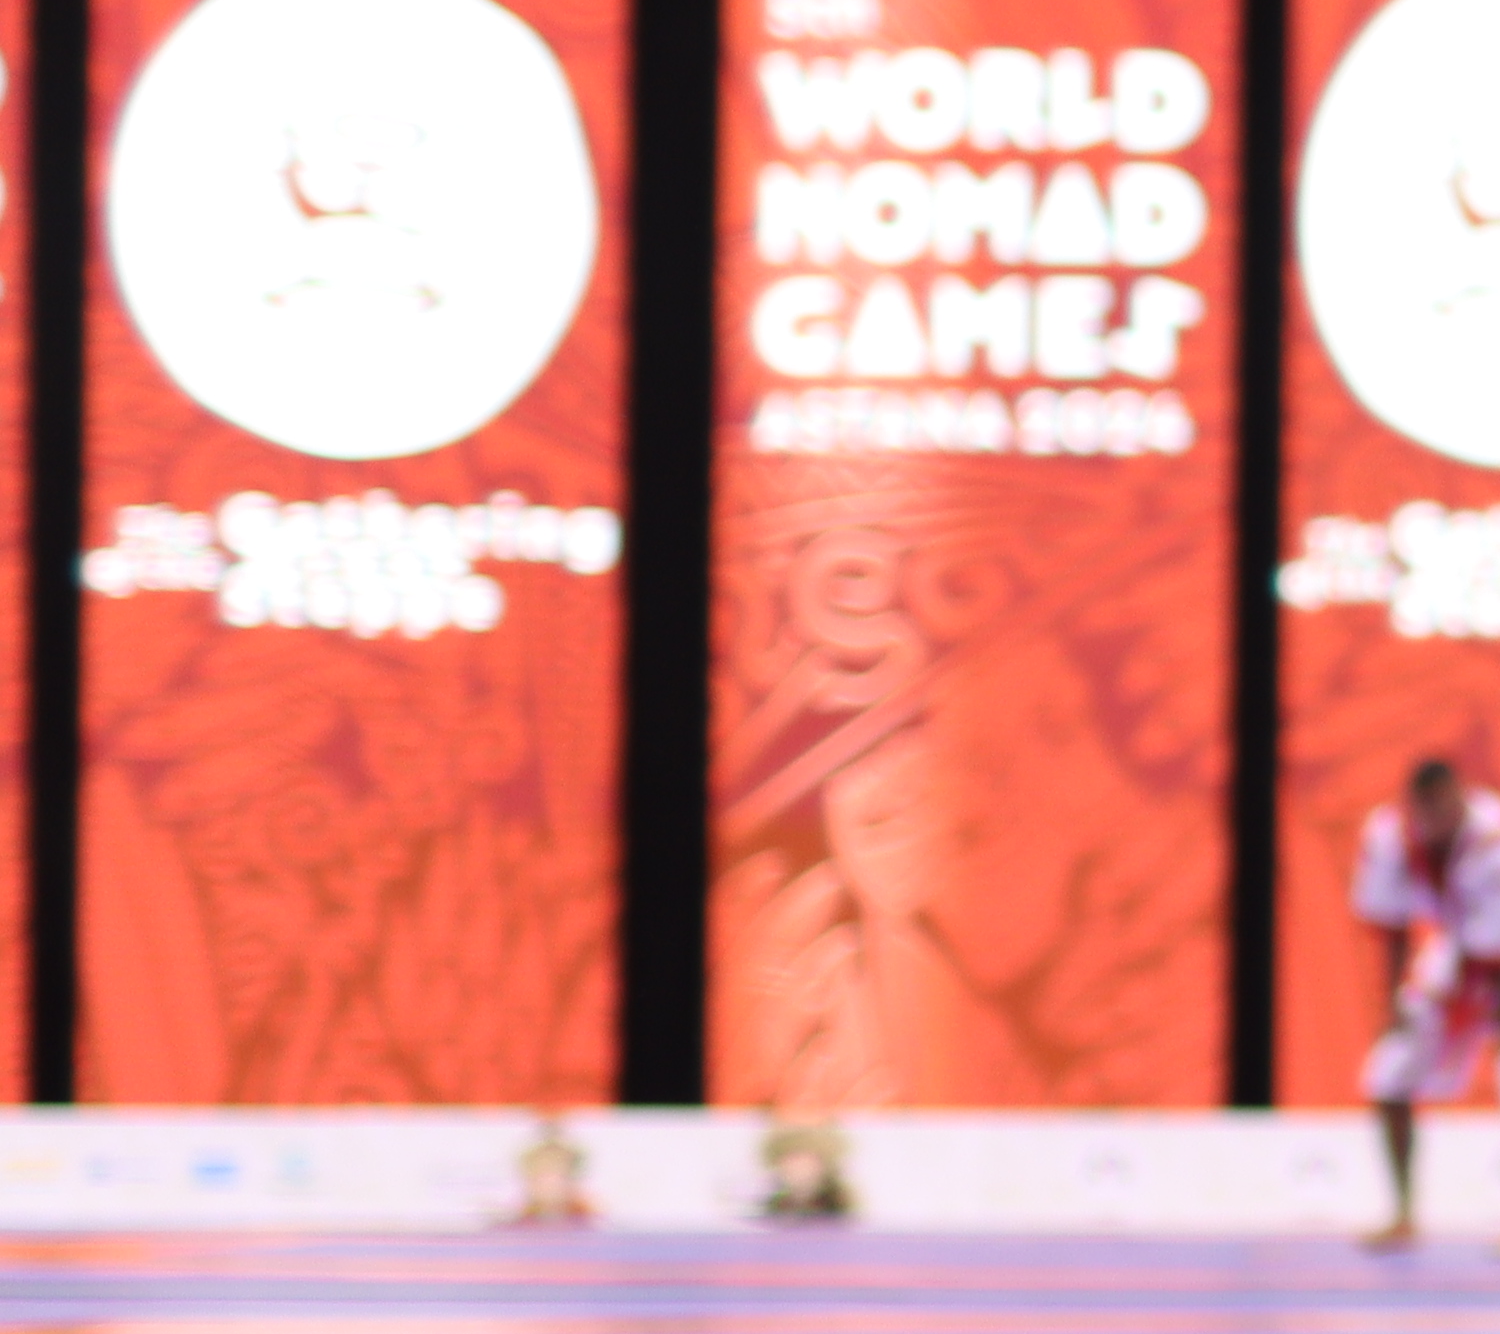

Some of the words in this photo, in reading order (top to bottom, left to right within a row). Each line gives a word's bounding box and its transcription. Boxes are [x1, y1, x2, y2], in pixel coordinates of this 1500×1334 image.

[757, 45, 1212, 153] WORLD
[755, 160, 1209, 269] NOMAD
[751, 274, 1206, 381] GAMES
